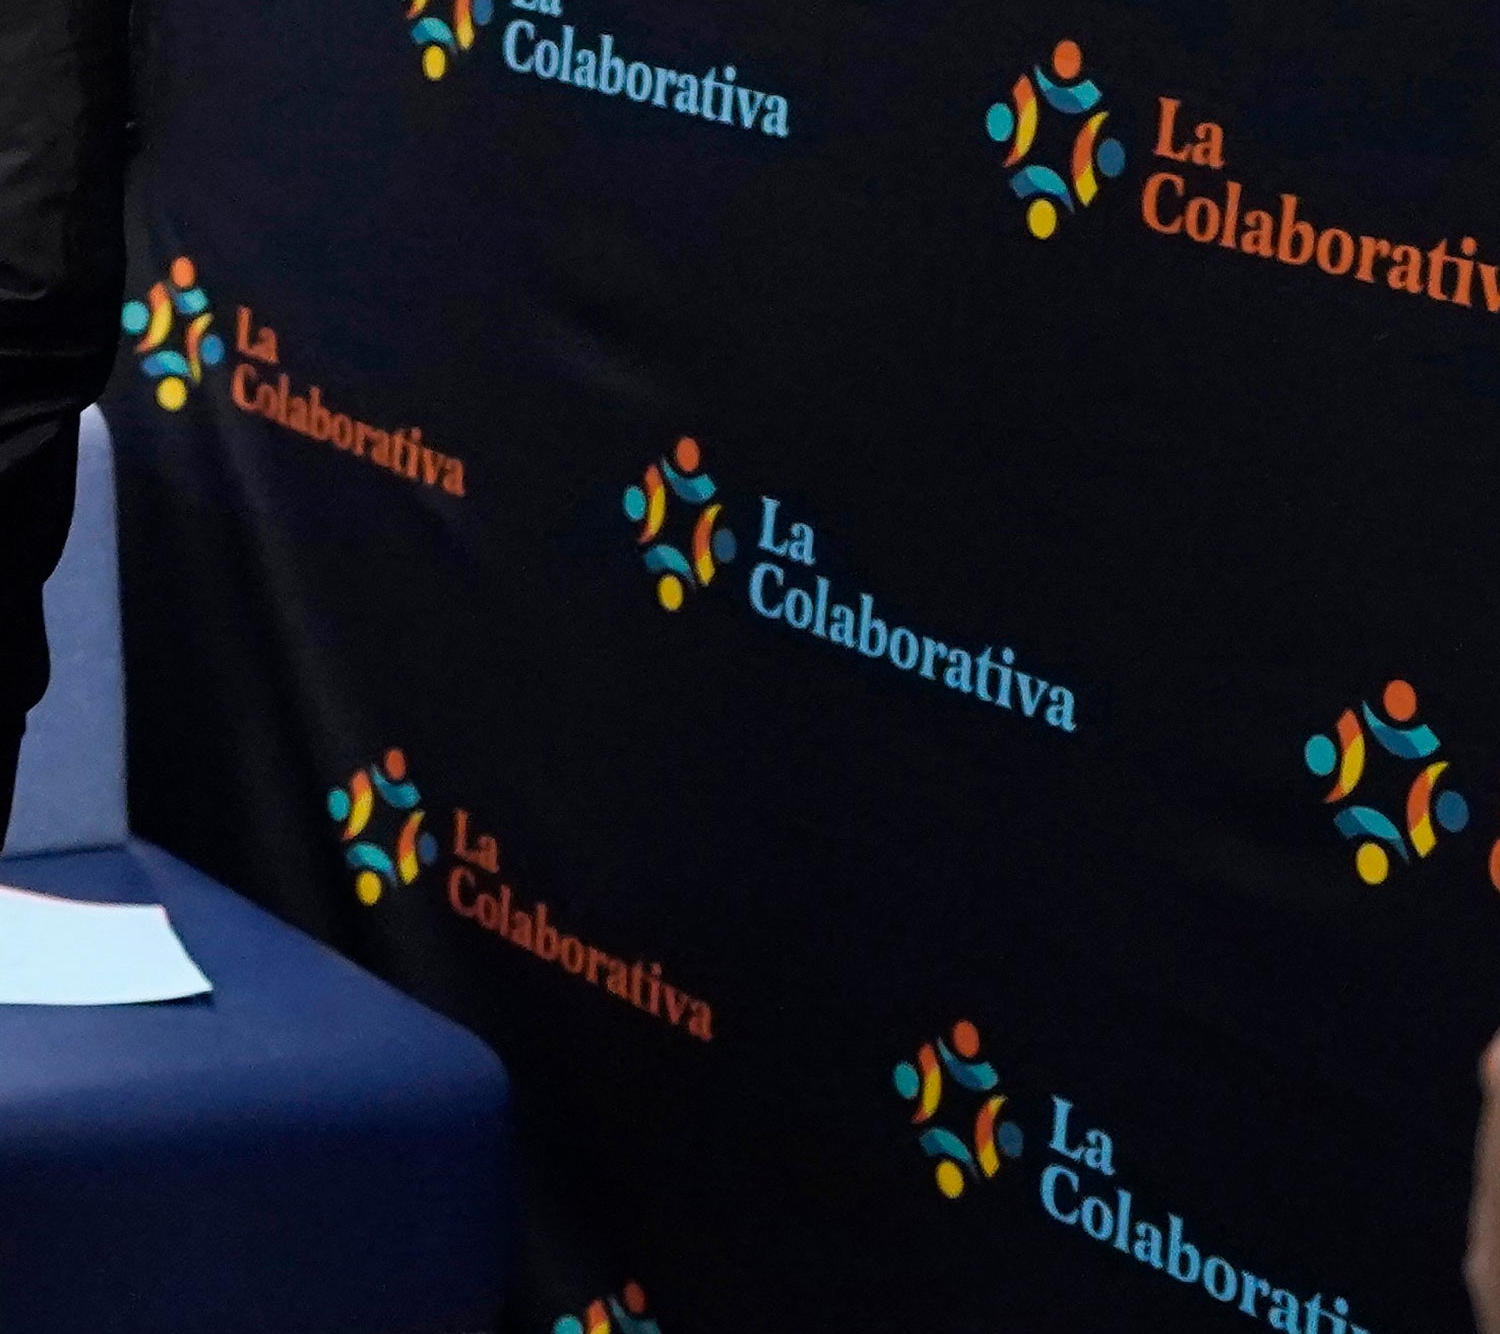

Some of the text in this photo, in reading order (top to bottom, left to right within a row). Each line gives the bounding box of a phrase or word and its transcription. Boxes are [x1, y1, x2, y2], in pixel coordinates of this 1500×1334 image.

[502, 19, 789, 138] Colaborativa
[1154, 97, 1226, 170] La
[236, 306, 279, 365] La
[230, 363, 466, 496] Colaborativa
[757, 496, 817, 567] La
[748, 562, 1076, 734] Colaborativa
[453, 809, 500, 874] La
[447, 866, 714, 1042] Colaborativa
[1048, 1096, 1116, 1176] La
